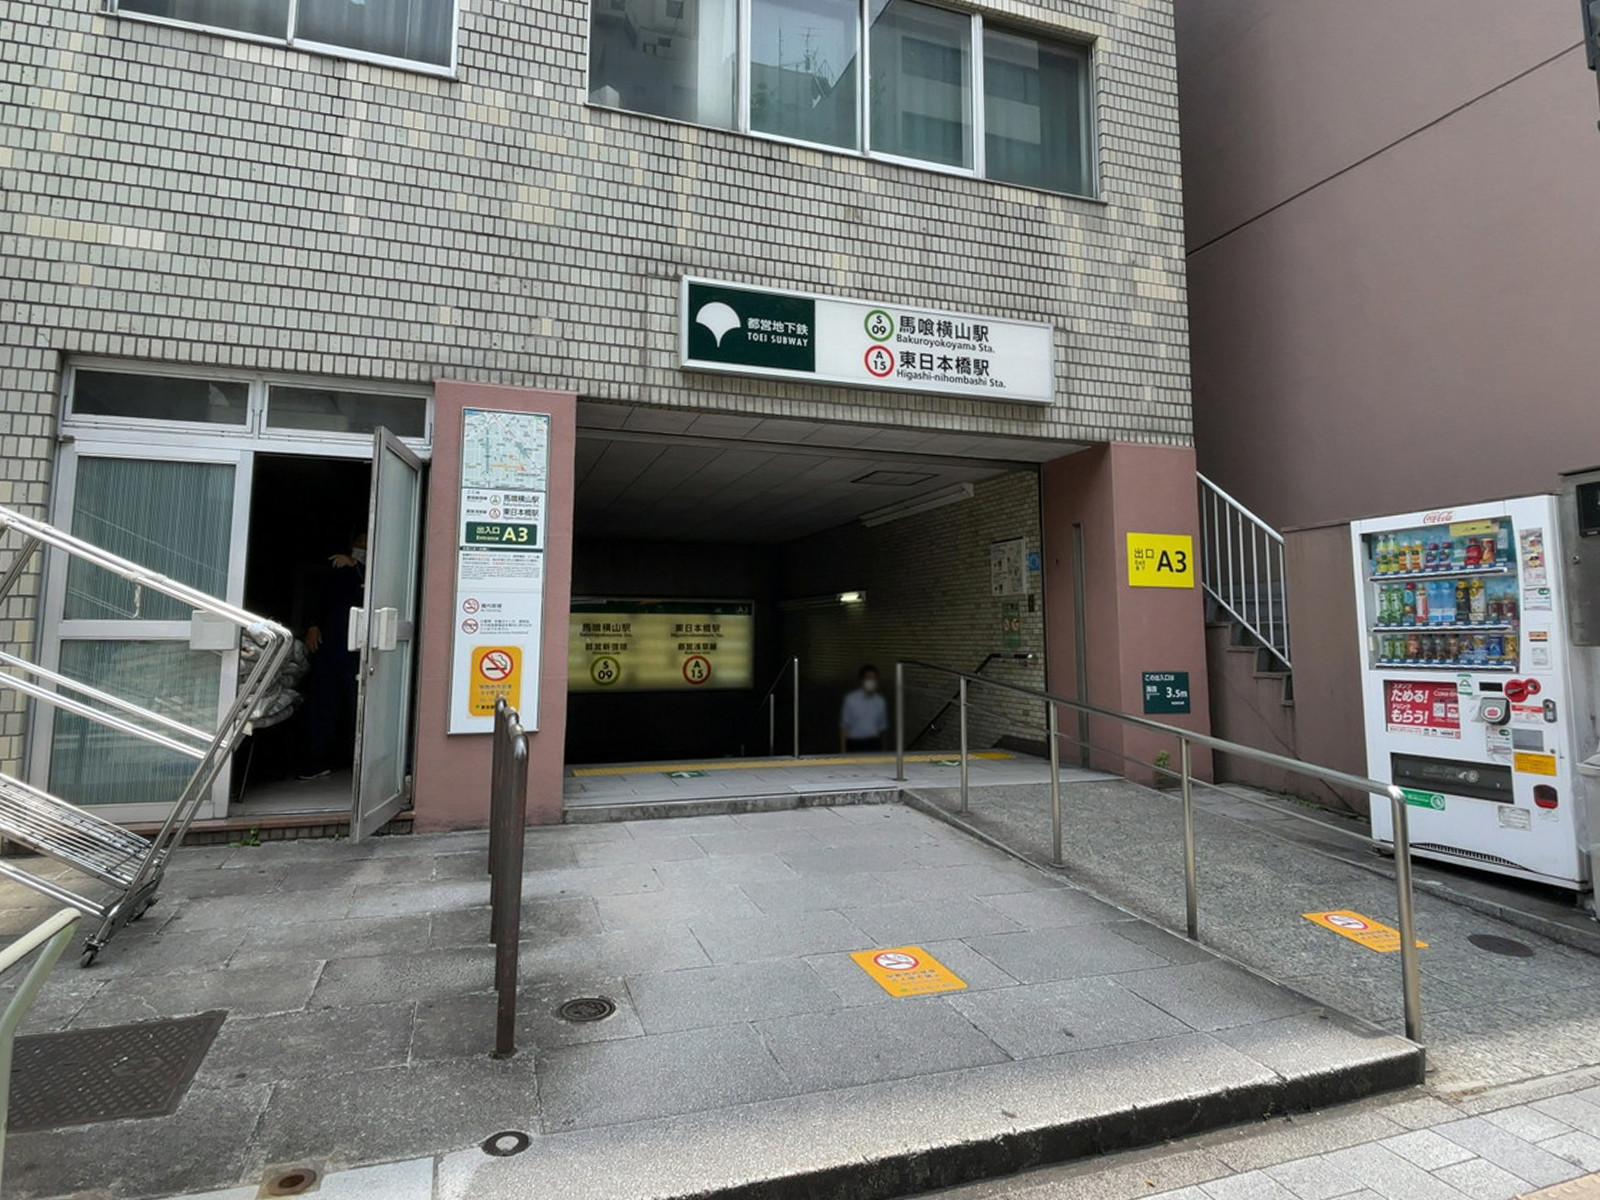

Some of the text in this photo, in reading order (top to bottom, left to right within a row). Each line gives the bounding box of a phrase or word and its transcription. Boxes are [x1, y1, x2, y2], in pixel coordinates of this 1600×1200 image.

[876, 315, 883, 324] S
[747, 317, 809, 336] 都営地下鉄
[871, 325, 887, 335] 09
[899, 315, 989, 342] 馬喰横山駅
[747, 332, 808, 347] TOEI SUBWAY
[896, 333, 995, 353] Bakuroyokoyama Sta.
[875, 351, 883, 360] A
[873, 360, 887, 371] 15
[899, 350, 989, 377] 東日本橋駅
[896, 369, 1006, 388] Higashi-nihombashi Sta.
[1423, 511, 1453, 524] Coca-Cola
[476, 526, 500, 534] 出入口
[502, 526, 528, 542] A3
[1134, 547, 1154, 559] 出口
[1156, 550, 1187, 573] A3
[603, 661, 609, 669] S
[693, 660, 701, 669] A
[598, 670, 613, 679] 09
[691, 669, 703, 678] 15
[1391, 689, 1429, 703] ためる!
[1391, 710, 1429, 724] もらう!
